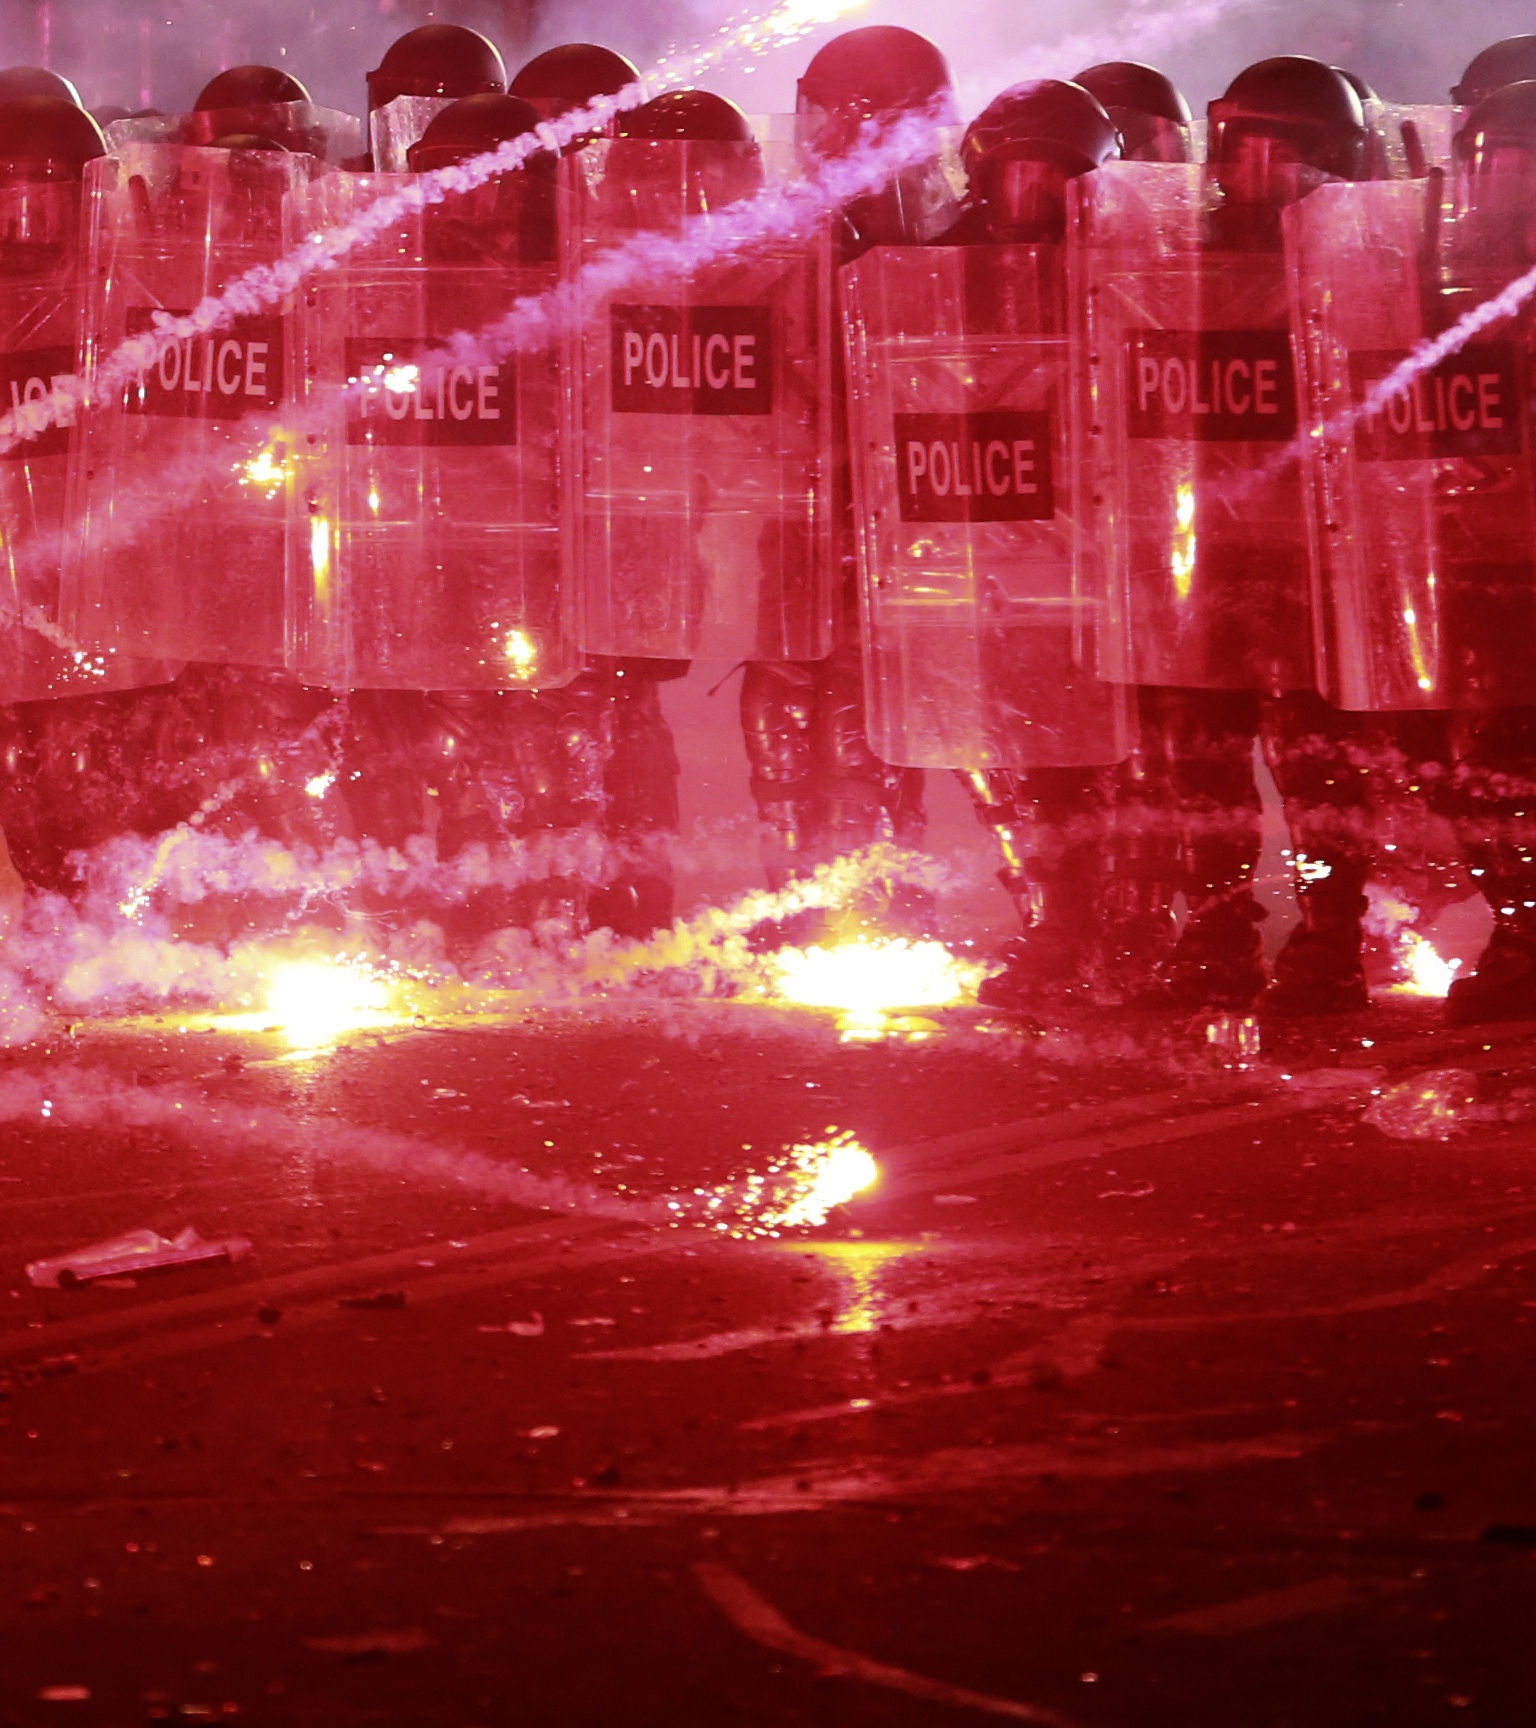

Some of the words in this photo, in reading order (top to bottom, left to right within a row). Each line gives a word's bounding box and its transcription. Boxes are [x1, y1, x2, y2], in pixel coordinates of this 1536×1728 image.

[625, 333, 756, 389] POLICE
[1138, 356, 1278, 415] POLICE
[908, 439, 1038, 495] POLICE
